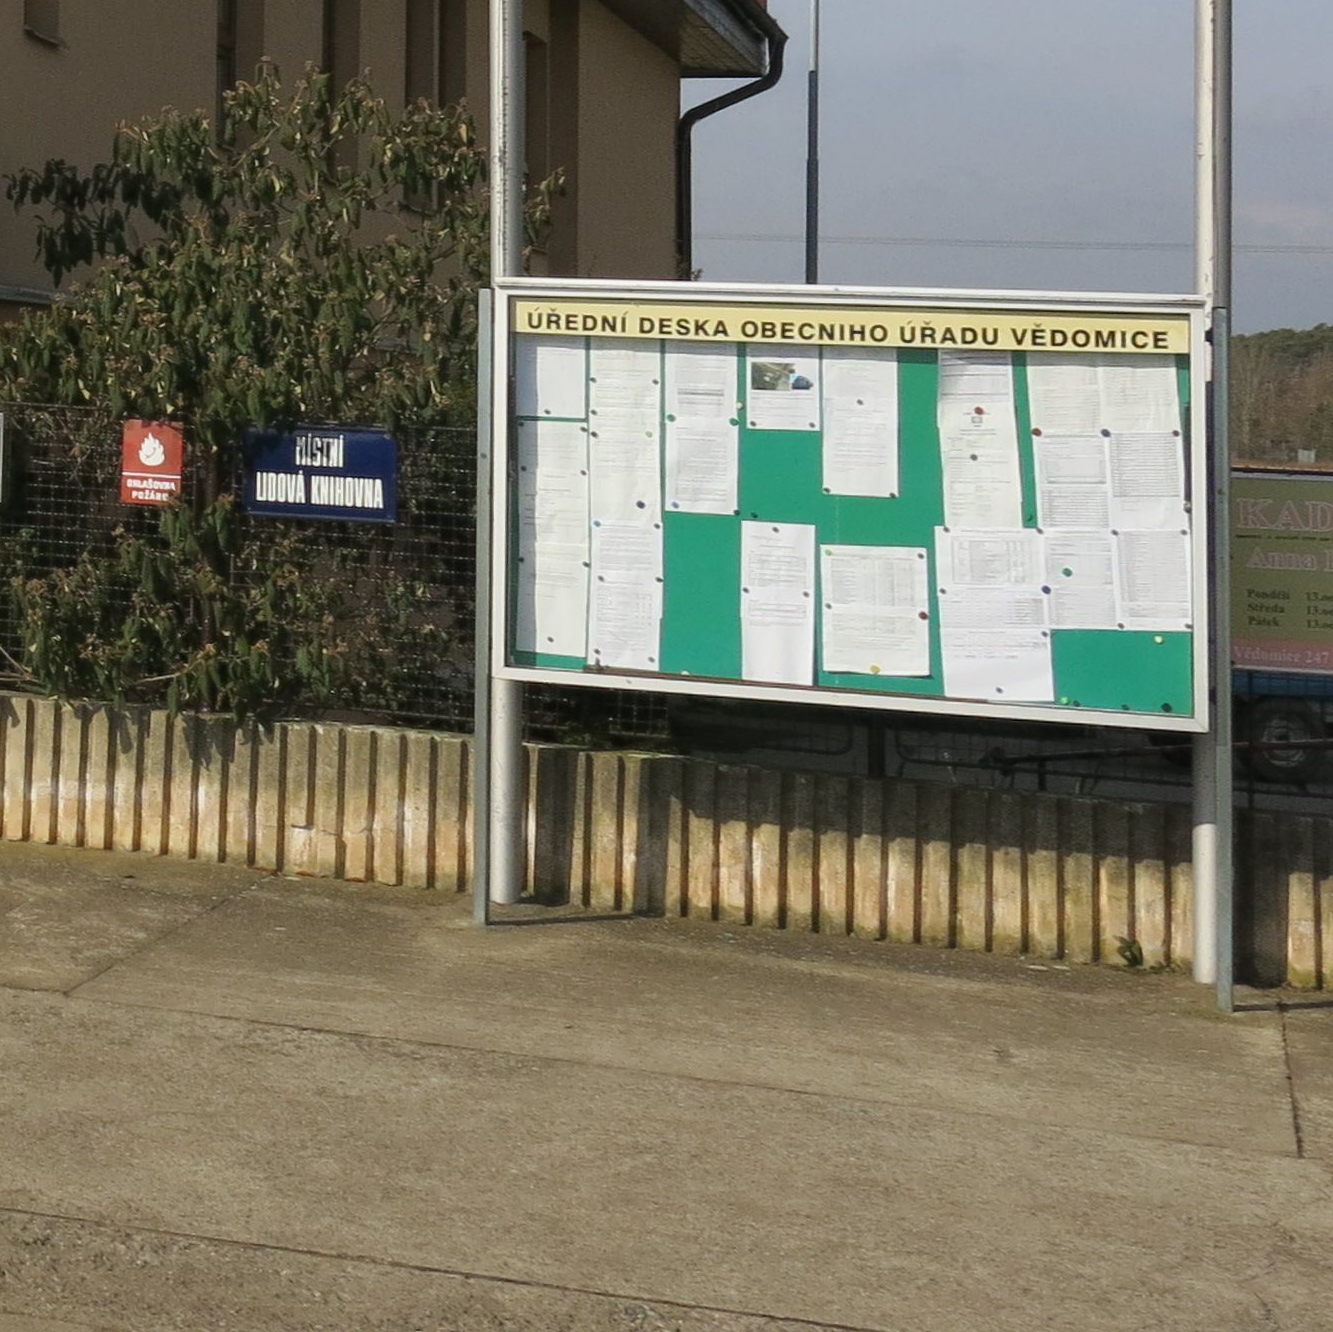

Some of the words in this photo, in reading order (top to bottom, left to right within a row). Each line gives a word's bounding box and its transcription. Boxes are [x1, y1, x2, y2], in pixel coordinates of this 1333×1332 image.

[527, 307, 628, 333] ÚŘEDNÍ
[638, 317, 730, 338] DESKA
[740, 320, 889, 342] OBECNIHO
[899, 321, 999, 345] ÚŘADU
[1012, 323, 1170, 350] VĚDOMICE
[295, 433, 344, 467] MÍSTNÍ
[256, 470, 306, 504] LIDOVÁ
[310, 475, 384, 509] KNIHOVNA
[1236, 498, 1333, 532] KAD
